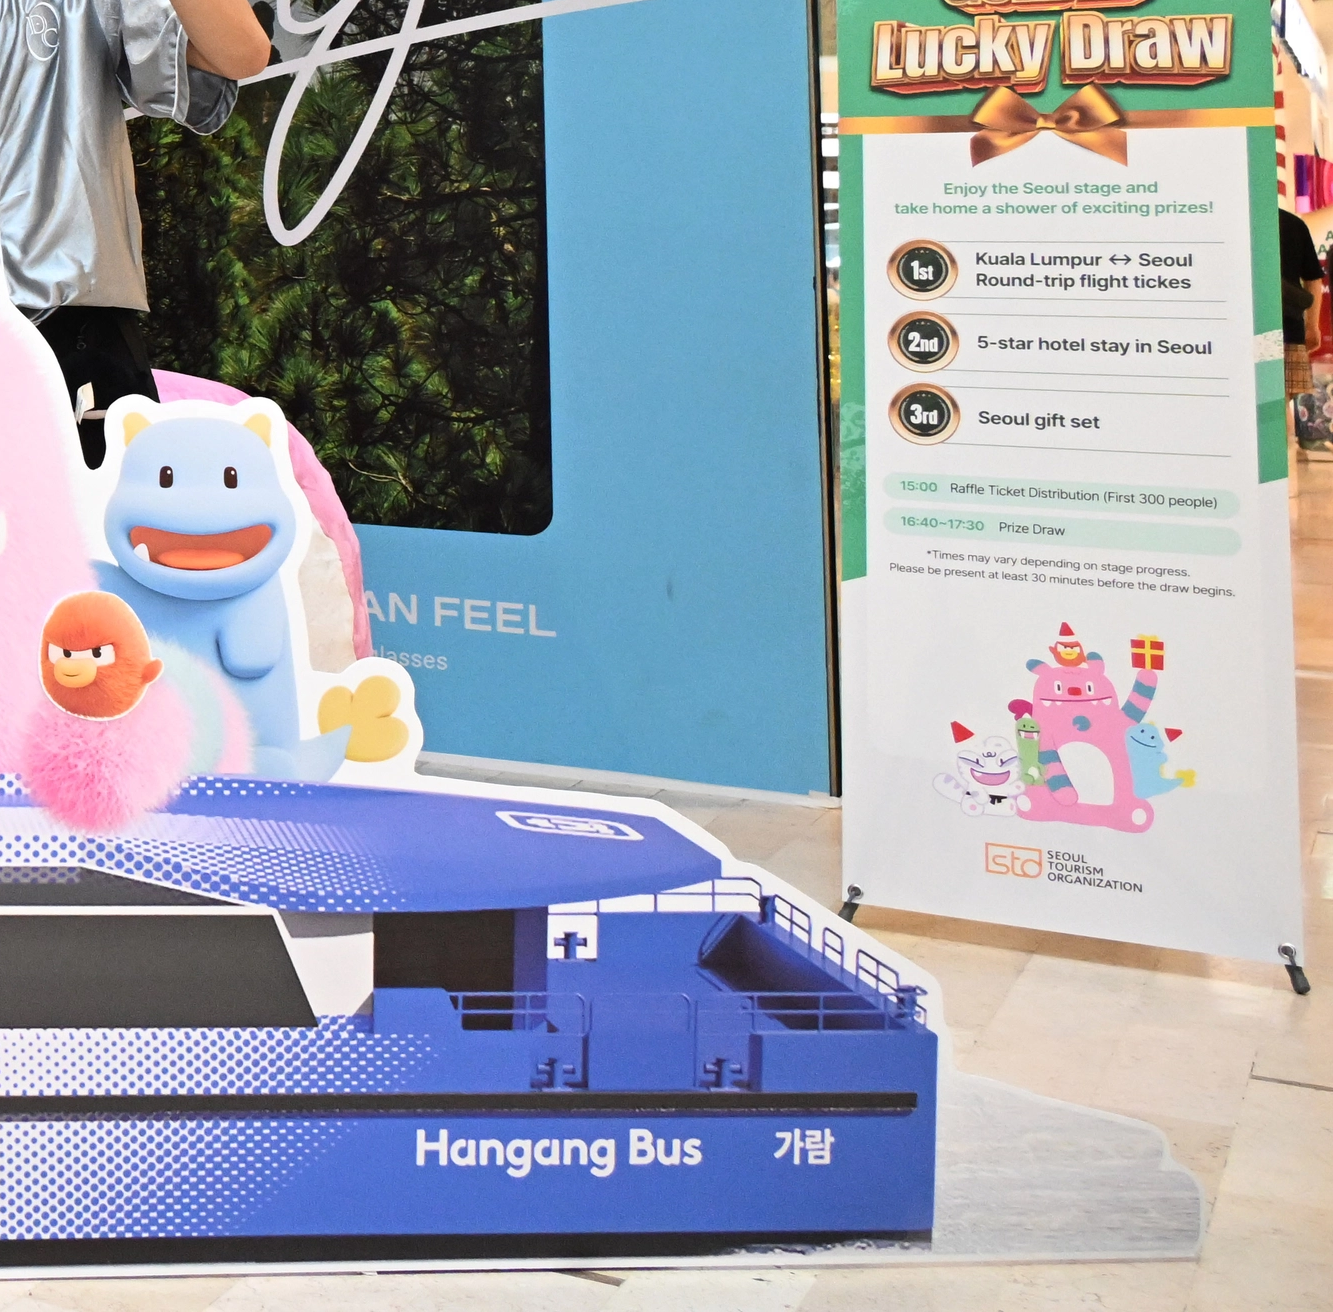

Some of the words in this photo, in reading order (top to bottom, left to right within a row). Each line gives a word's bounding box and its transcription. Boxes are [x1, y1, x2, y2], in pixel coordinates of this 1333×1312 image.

[873, 16, 1055, 88] Lucky
[1062, 13, 1232, 78] Draw
[943, 181, 989, 198] Enjoy
[992, 181, 1020, 195] the
[1023, 181, 1070, 195] Seoul
[1073, 182, 1122, 199] stage
[1125, 180, 1159, 195] and
[894, 201, 929, 216] take
[932, 201, 978, 216] home
[982, 204, 992, 216] a
[995, 201, 1058, 216] shower
[1061, 201, 1079, 215] of
[1082, 201, 1151, 220] exciting
[1154, 201, 1215, 220] prizes!
[910, 260, 934, 281] 1st
[975, 252, 1026, 267] Kuala
[1030, 253, 1103, 270] Lumpur
[1138, 253, 1193, 268] Seoul
[975, 274, 1076, 291] Round-trip
[1079, 274, 1129, 292] flight
[1133, 275, 1192, 290] tickes
[907, 331, 939, 353] 2nd
[977, 335, 1034, 351] 5-star
[1037, 337, 1086, 353] hotel
[1088, 339, 1130, 356] stay
[1134, 339, 1152, 354] in
[1156, 339, 1213, 356] Seoul
[909, 403, 939, 425] 3rd
[977, 411, 1030, 427] Seoul
[1033, 412, 1066, 431] gift
[1070, 414, 1101, 430] set
[900, 480, 938, 494] 15:00
[950, 482, 985, 496] Raffle
[988, 483, 1026, 498] Ticket
[1028, 486, 1100, 503] Distribution
[1103, 490, 1136, 505] (First
[1139, 492, 1166, 506] 300
[1168, 494, 1219, 511] people)
[900, 516, 985, 533] 16:40~17:30
[998, 520, 1030, 535] Prize
[1033, 523, 1066, 537] Draw
[967, 553, 991, 566] may
[994, 555, 1017, 568] vary
[1020, 555, 1081, 572] depending
[1083, 561, 1098, 571] on
[1101, 562, 1133, 576] stage
[1136, 566, 1191, 579] progress.
[889, 562, 925, 576] Please
[927, 565, 941, 577] be
[944, 568, 985, 581] present
[988, 571, 999, 580] at
[1001, 570, 1029, 583] least
[1031, 573, 1047, 584] 30
[1049, 573, 1094, 587] minutes
[1097, 576, 1134, 590] before
[1137, 579, 1157, 591] the
[1160, 581, 1189, 594] draw
[1192, 583, 1236, 598] begins.
[434, 596, 557, 638] FEEL
[1047, 850, 1088, 864] SEOUL
[1047, 861, 1104, 876] TOURISM
[1047, 872, 1143, 893] ORGANIZATION
[416, 1128, 616, 1178] Hangang
[629, 1128, 703, 1166] Bus
[773, 1127, 835, 1166] 가람
